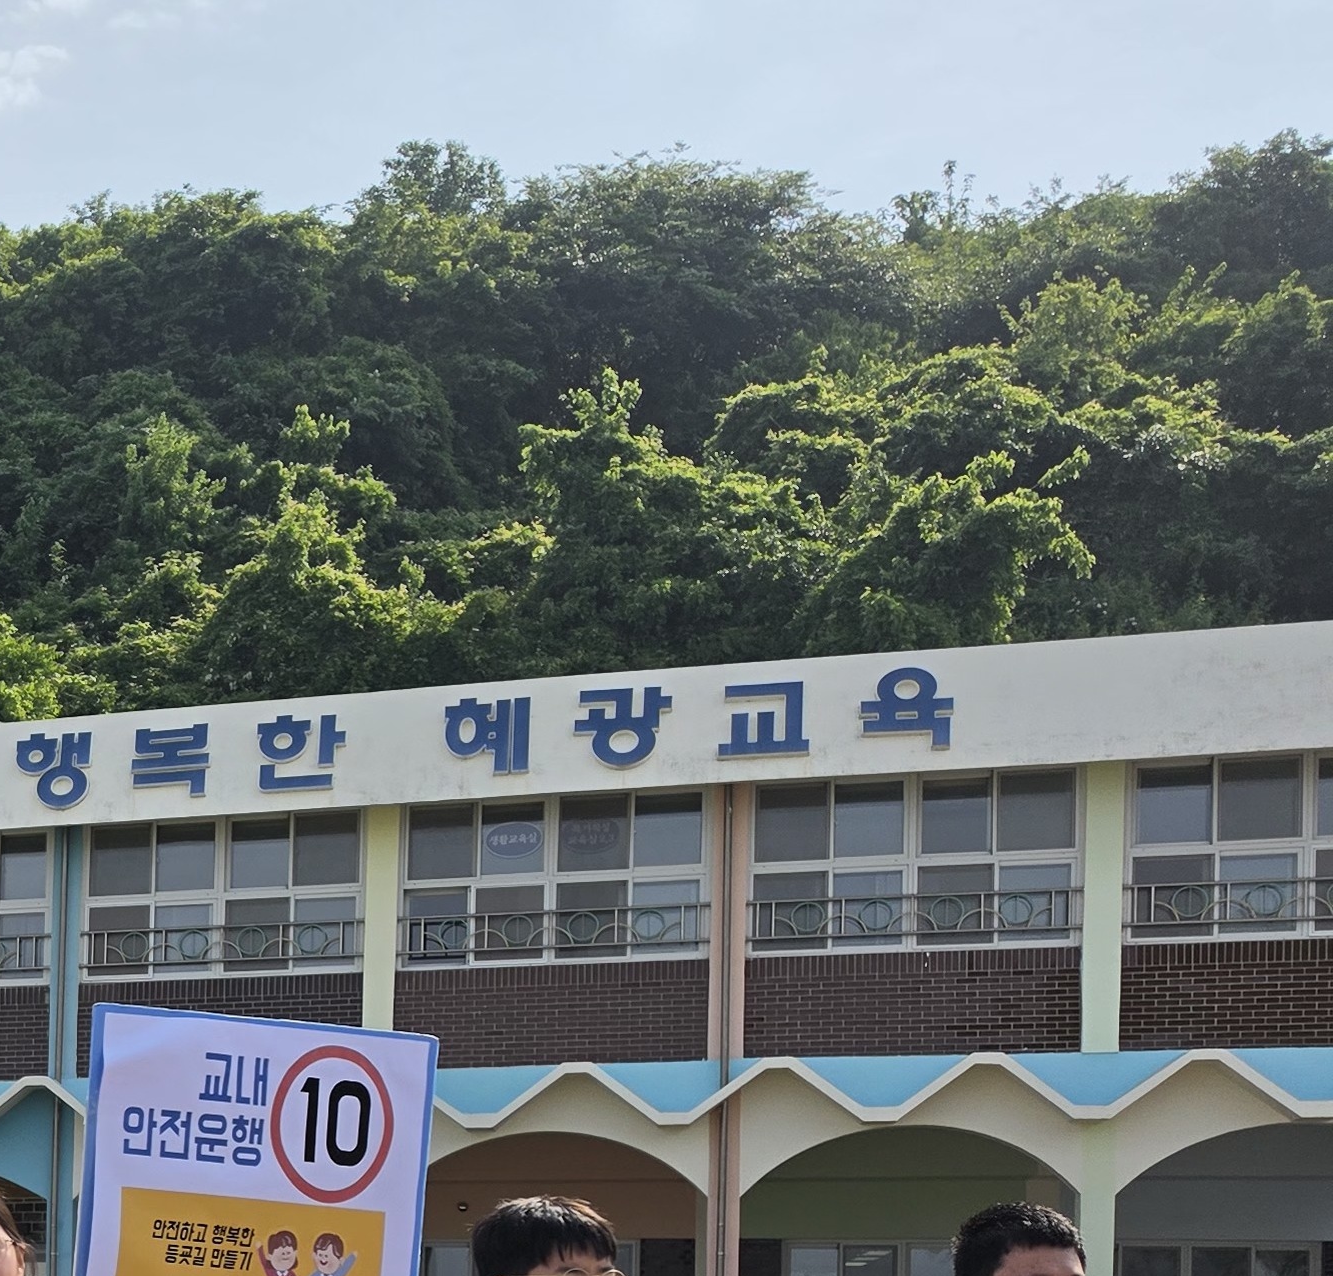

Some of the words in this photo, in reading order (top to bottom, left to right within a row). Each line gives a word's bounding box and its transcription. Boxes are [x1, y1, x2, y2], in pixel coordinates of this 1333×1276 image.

[15, 714, 347, 811] 행복한
[199, 1051, 269, 1107] 교내
[122, 1106, 264, 1167] 안전운행
[301, 1076, 372, 1167] 10
[152, 1219, 208, 1243] 안전하고
[212, 1225, 255, 1247] 행복한
[165, 1244, 207, 1267] 등굣길
[210, 1248, 253, 1271] 만들기
